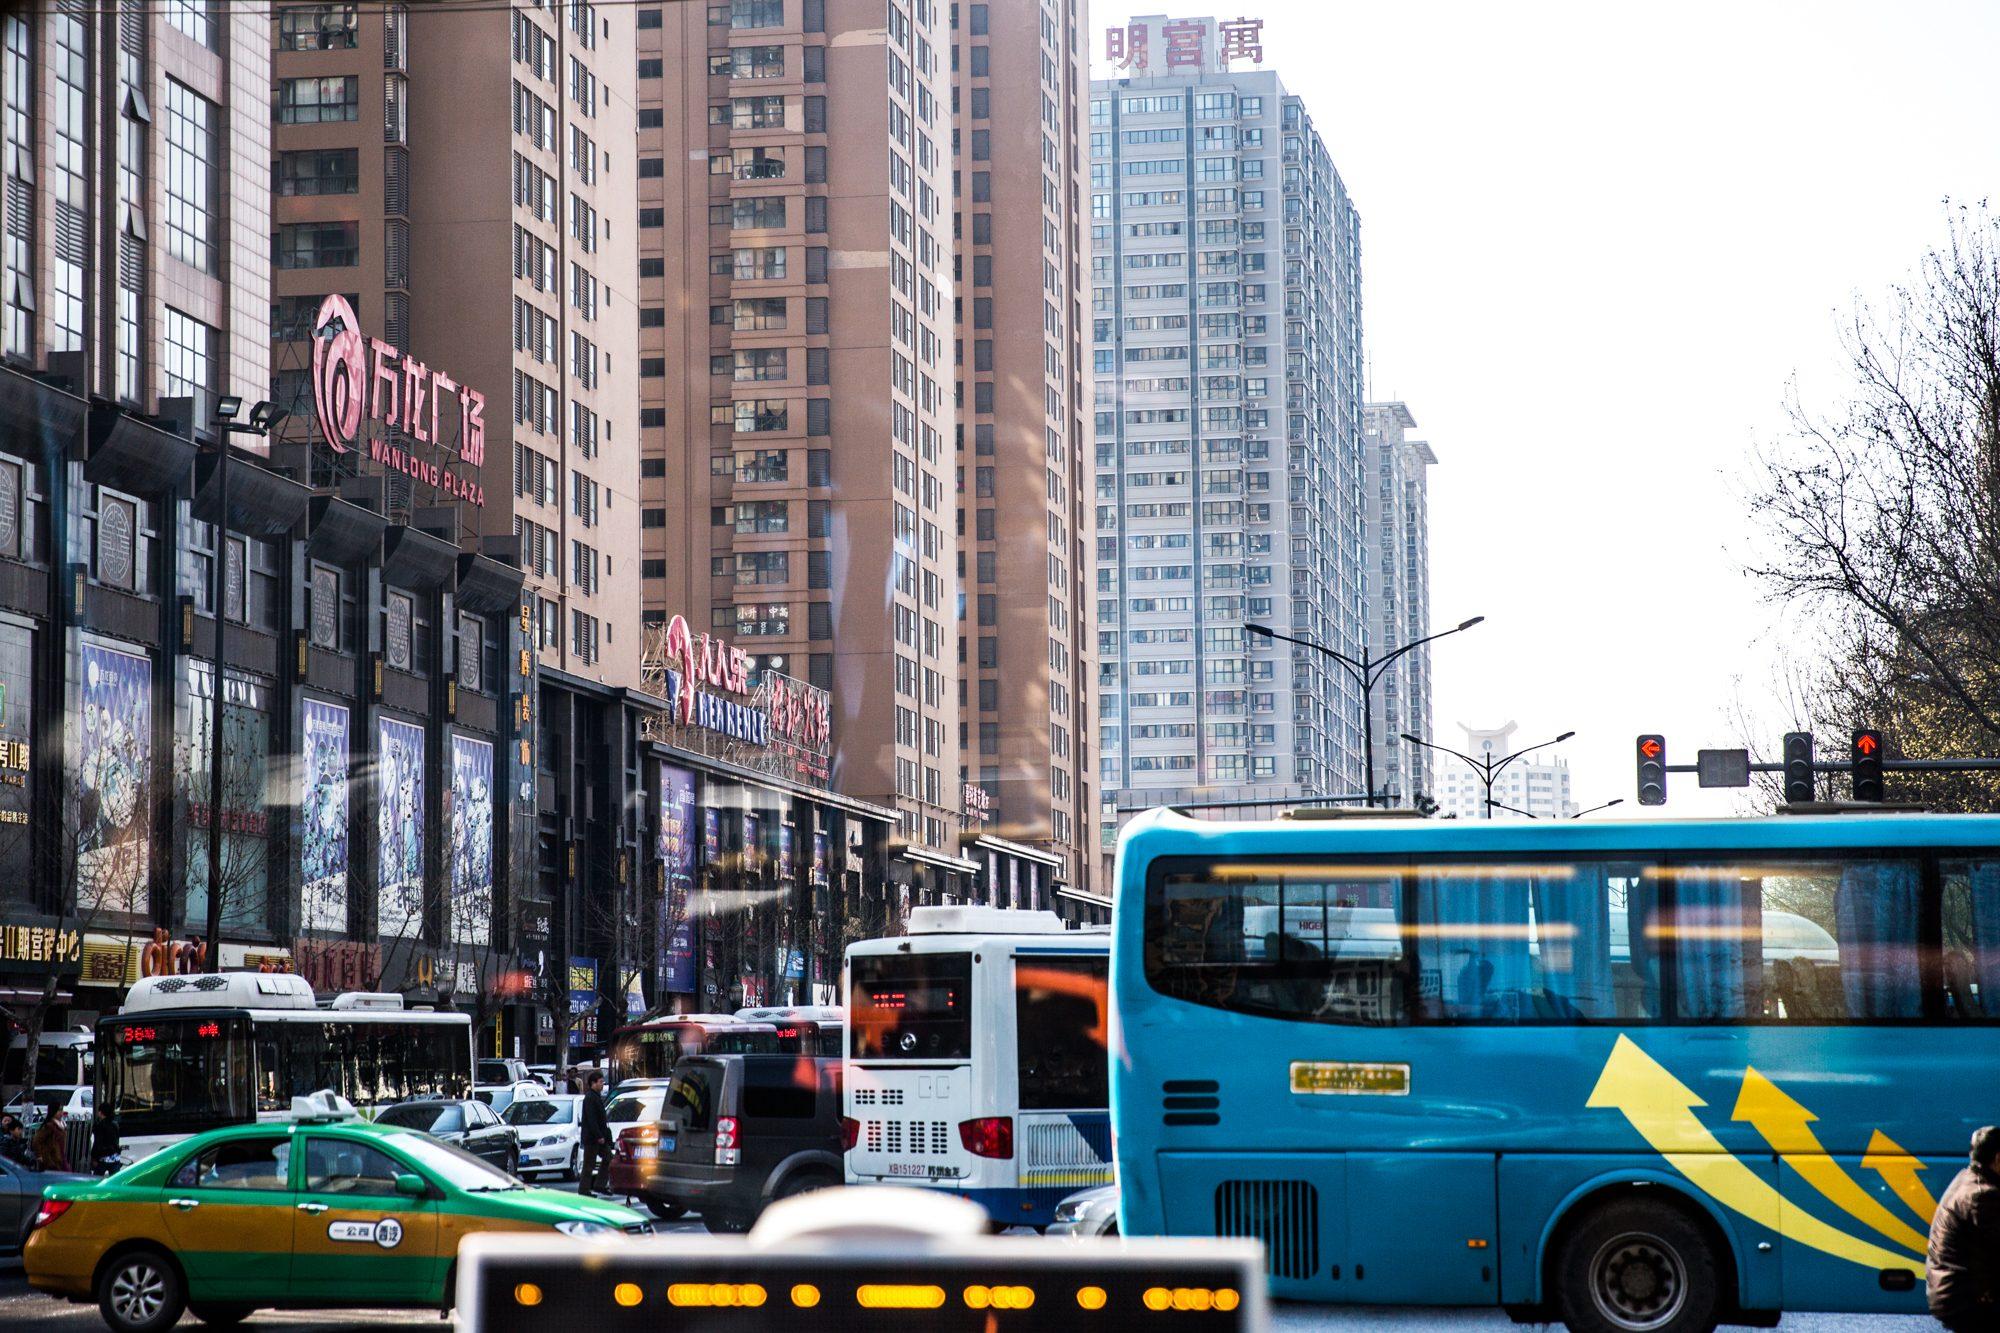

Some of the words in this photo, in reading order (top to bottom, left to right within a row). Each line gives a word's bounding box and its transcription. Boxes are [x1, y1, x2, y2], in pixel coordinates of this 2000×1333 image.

[1106, 16, 1264, 71] 明宫寓
[369, 337, 486, 468] 万龙广场
[370, 437, 439, 486] WANLONG
[443, 470, 486, 507] PLAZA
[695, 632, 748, 696] 人人乐
[1299, 921, 1325, 931] HIGE
[888, 1164, 926, 1176] XB151227
[334, 1226, 369, 1237] 一公司
